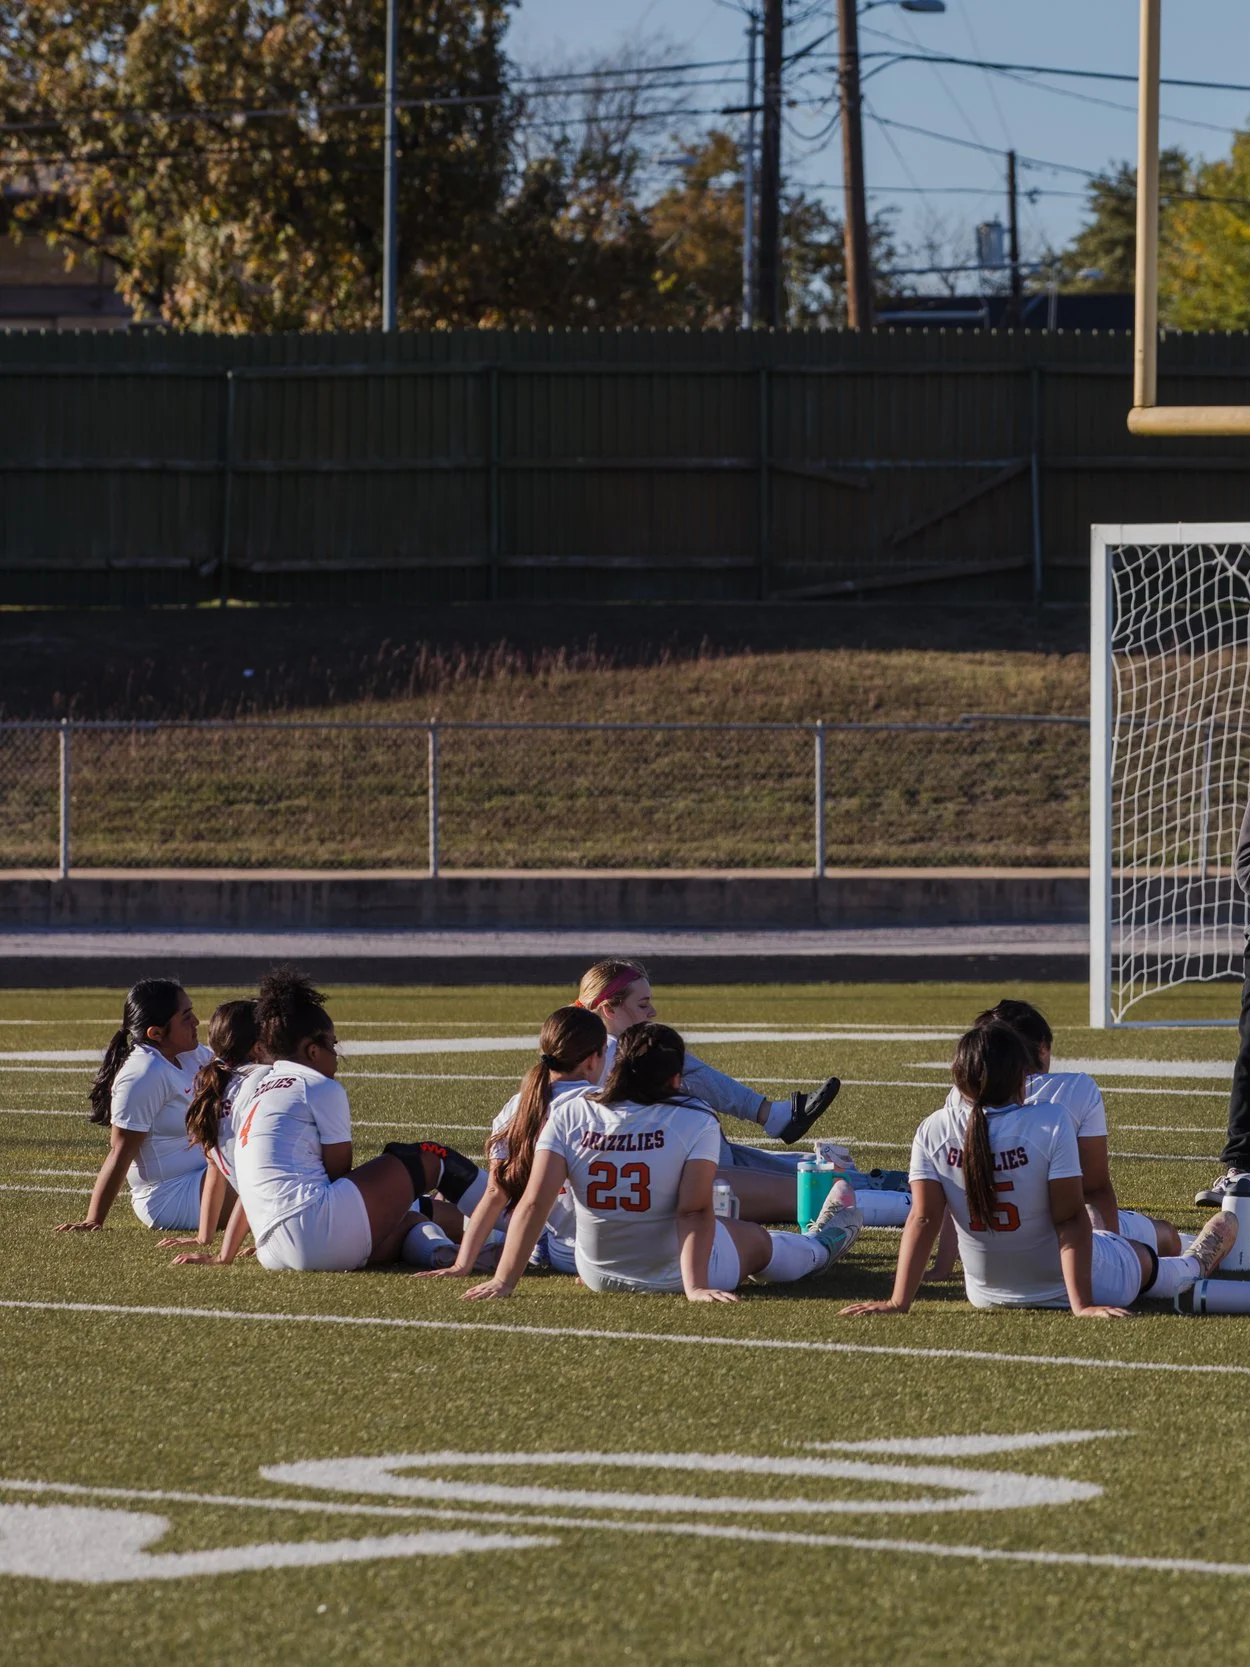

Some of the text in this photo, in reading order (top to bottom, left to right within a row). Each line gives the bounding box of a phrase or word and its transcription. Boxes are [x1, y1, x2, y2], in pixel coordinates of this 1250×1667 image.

[239, 1100, 261, 1148] 4
[581, 1129, 665, 1152] GRIZZLIES
[947, 1146, 1029, 1171] GLIES
[587, 1161, 652, 1212] 23
[969, 1181, 1021, 1232] 5
